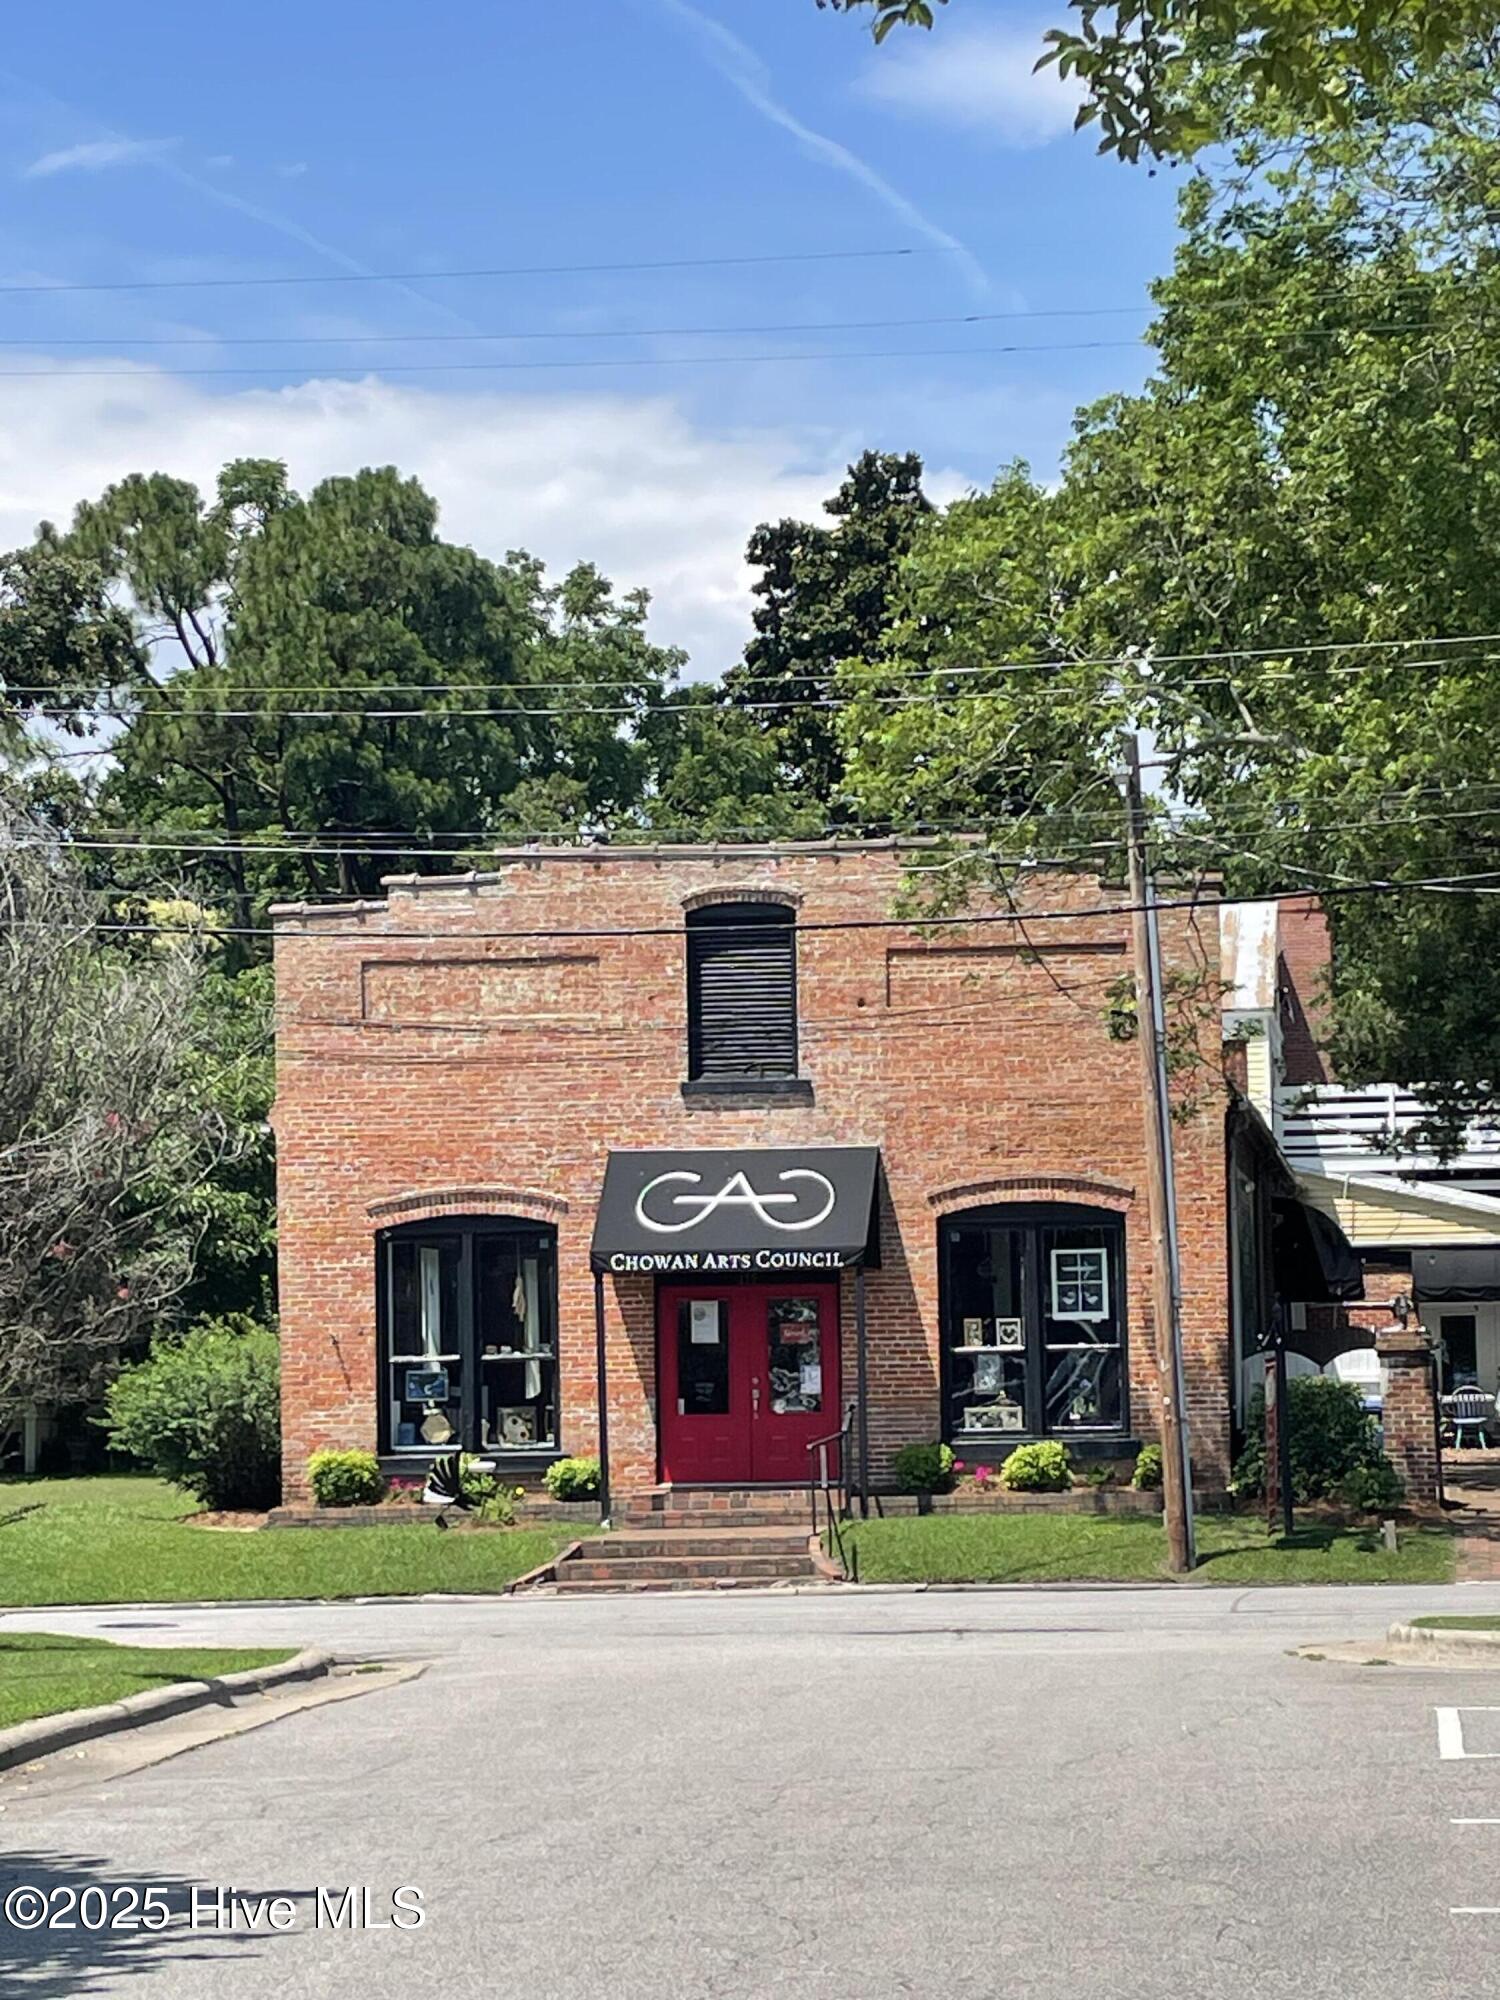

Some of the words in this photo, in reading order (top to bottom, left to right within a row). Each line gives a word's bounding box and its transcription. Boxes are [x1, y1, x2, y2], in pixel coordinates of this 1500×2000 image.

[610, 1253, 698, 1271] CHOWAN
[702, 1253, 751, 1269] ARTS
[755, 1250, 844, 1269] COUNCIL
